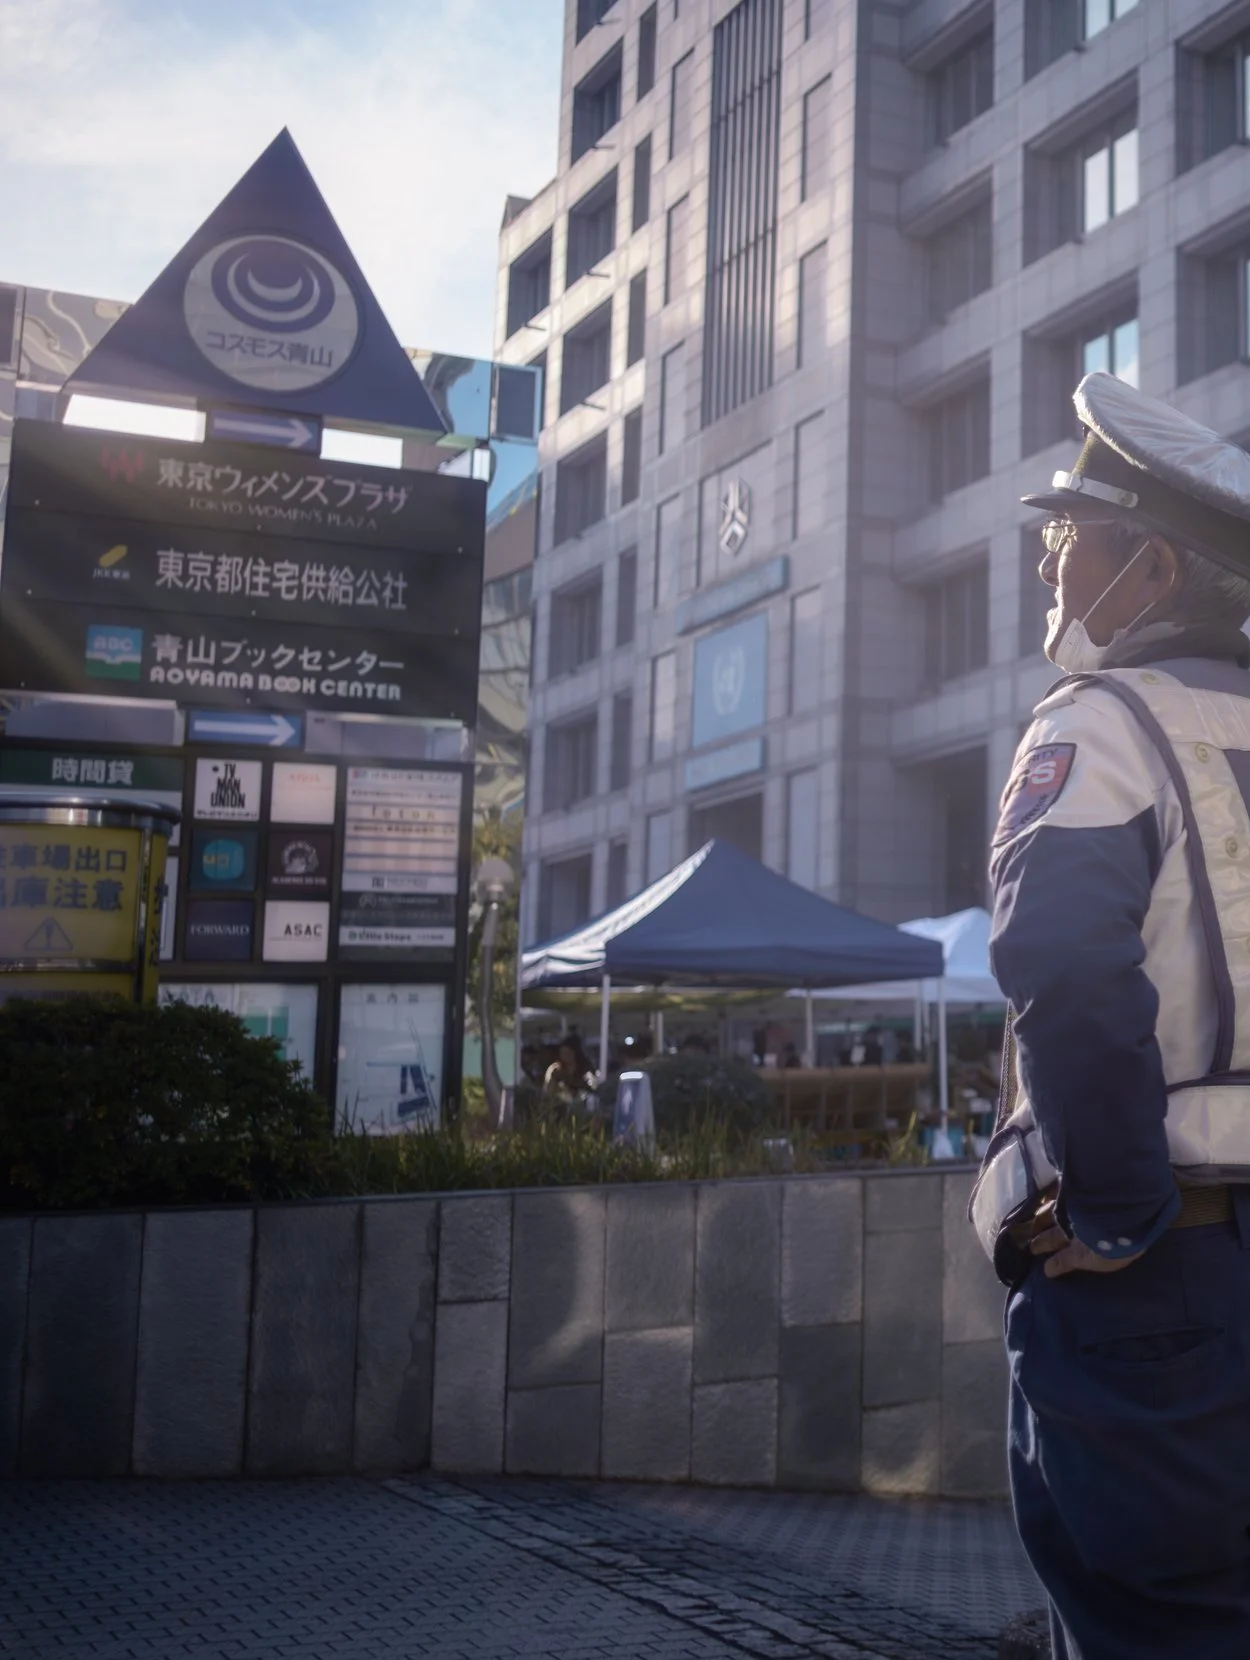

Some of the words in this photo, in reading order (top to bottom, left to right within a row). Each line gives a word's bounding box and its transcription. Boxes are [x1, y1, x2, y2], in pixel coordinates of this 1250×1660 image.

[205, 330, 333, 369] コスモス青山
[156, 457, 412, 514] 東京ウィメンズプラザ
[189, 497, 243, 515] TOKYO
[327, 512, 377, 531] PLAZA
[156, 548, 408, 611] 東京都住宅供給公社
[94, 635, 134, 652] ABC
[152, 633, 404, 673] 青山ブックセンター
[150, 666, 254, 691] AOYAMA
[259, 675, 316, 695] BOOK
[320, 680, 401, 700] CENTER
[52, 757, 135, 786] 時間貸
[217, 777, 241, 795] MAN
[224, 763, 236, 779] TV
[210, 792, 246, 809] UNION
[0, 875, 124, 912] 庫注意
[190, 923, 250, 937] FORWARD
[284, 923, 323, 938] ASAC
